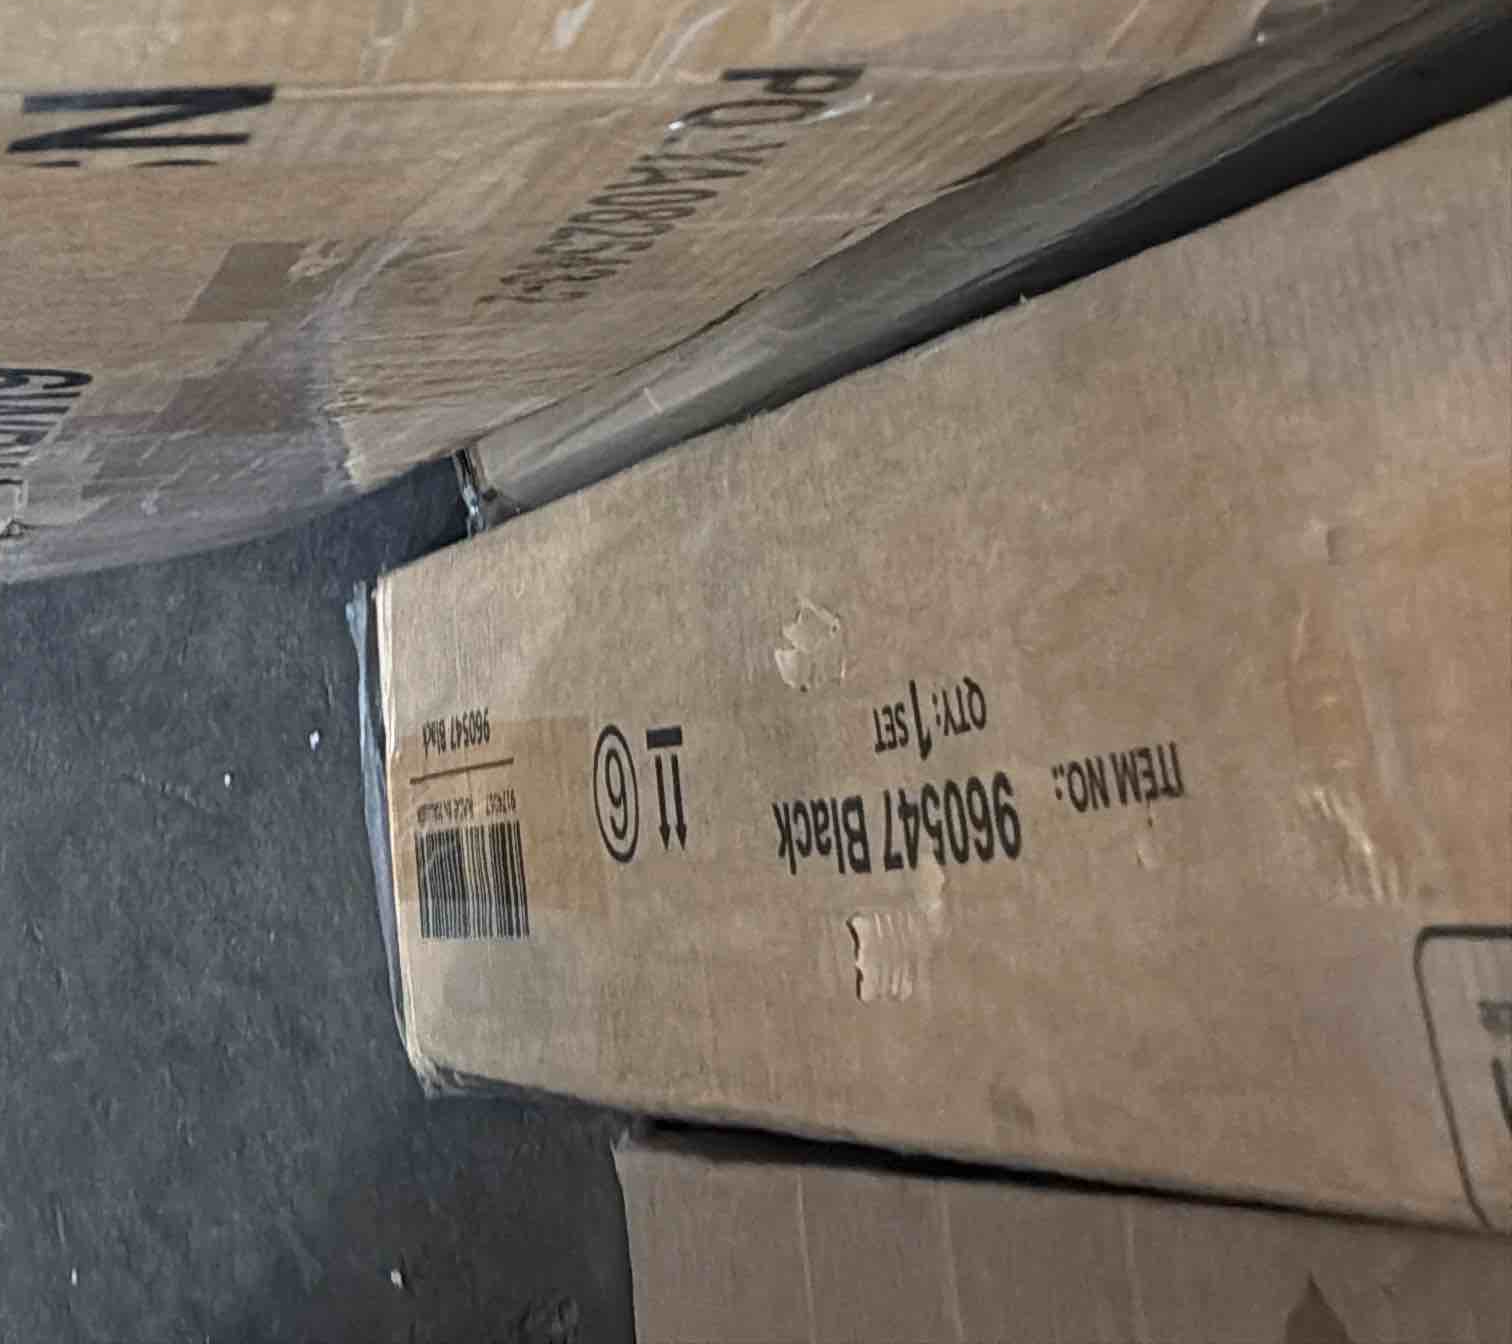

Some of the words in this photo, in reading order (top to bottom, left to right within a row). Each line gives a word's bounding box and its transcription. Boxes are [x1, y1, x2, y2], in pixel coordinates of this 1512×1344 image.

[449, 707, 491, 750] 960547
[873, 703, 908, 753] SET
[934, 675, 987, 737] QTY:
[1113, 740, 1184, 804] ITEM
[771, 794, 872, 876] Black
[883, 770, 1023, 873] 960547
